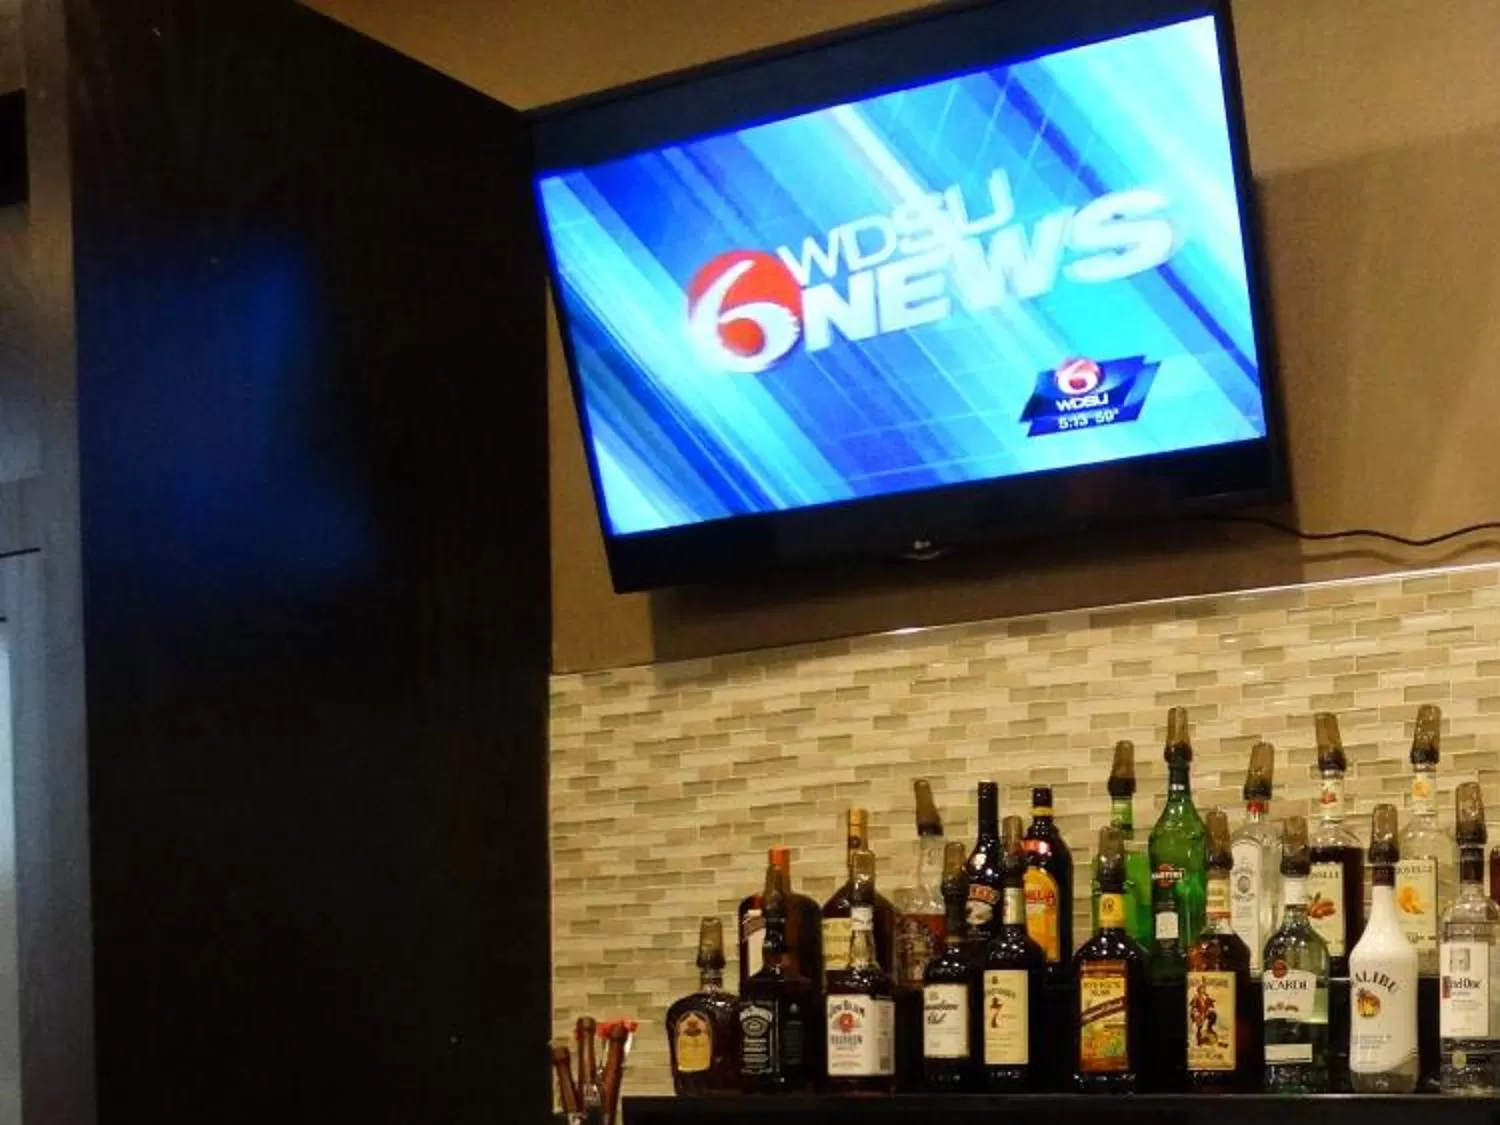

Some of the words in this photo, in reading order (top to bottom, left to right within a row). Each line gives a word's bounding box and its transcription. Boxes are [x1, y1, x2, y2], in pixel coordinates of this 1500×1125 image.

[690, 257, 801, 373] 6
[800, 187, 1177, 352] NEWS
[776, 167, 1016, 286] WDSU
[1055, 392, 1109, 412] WDSU
